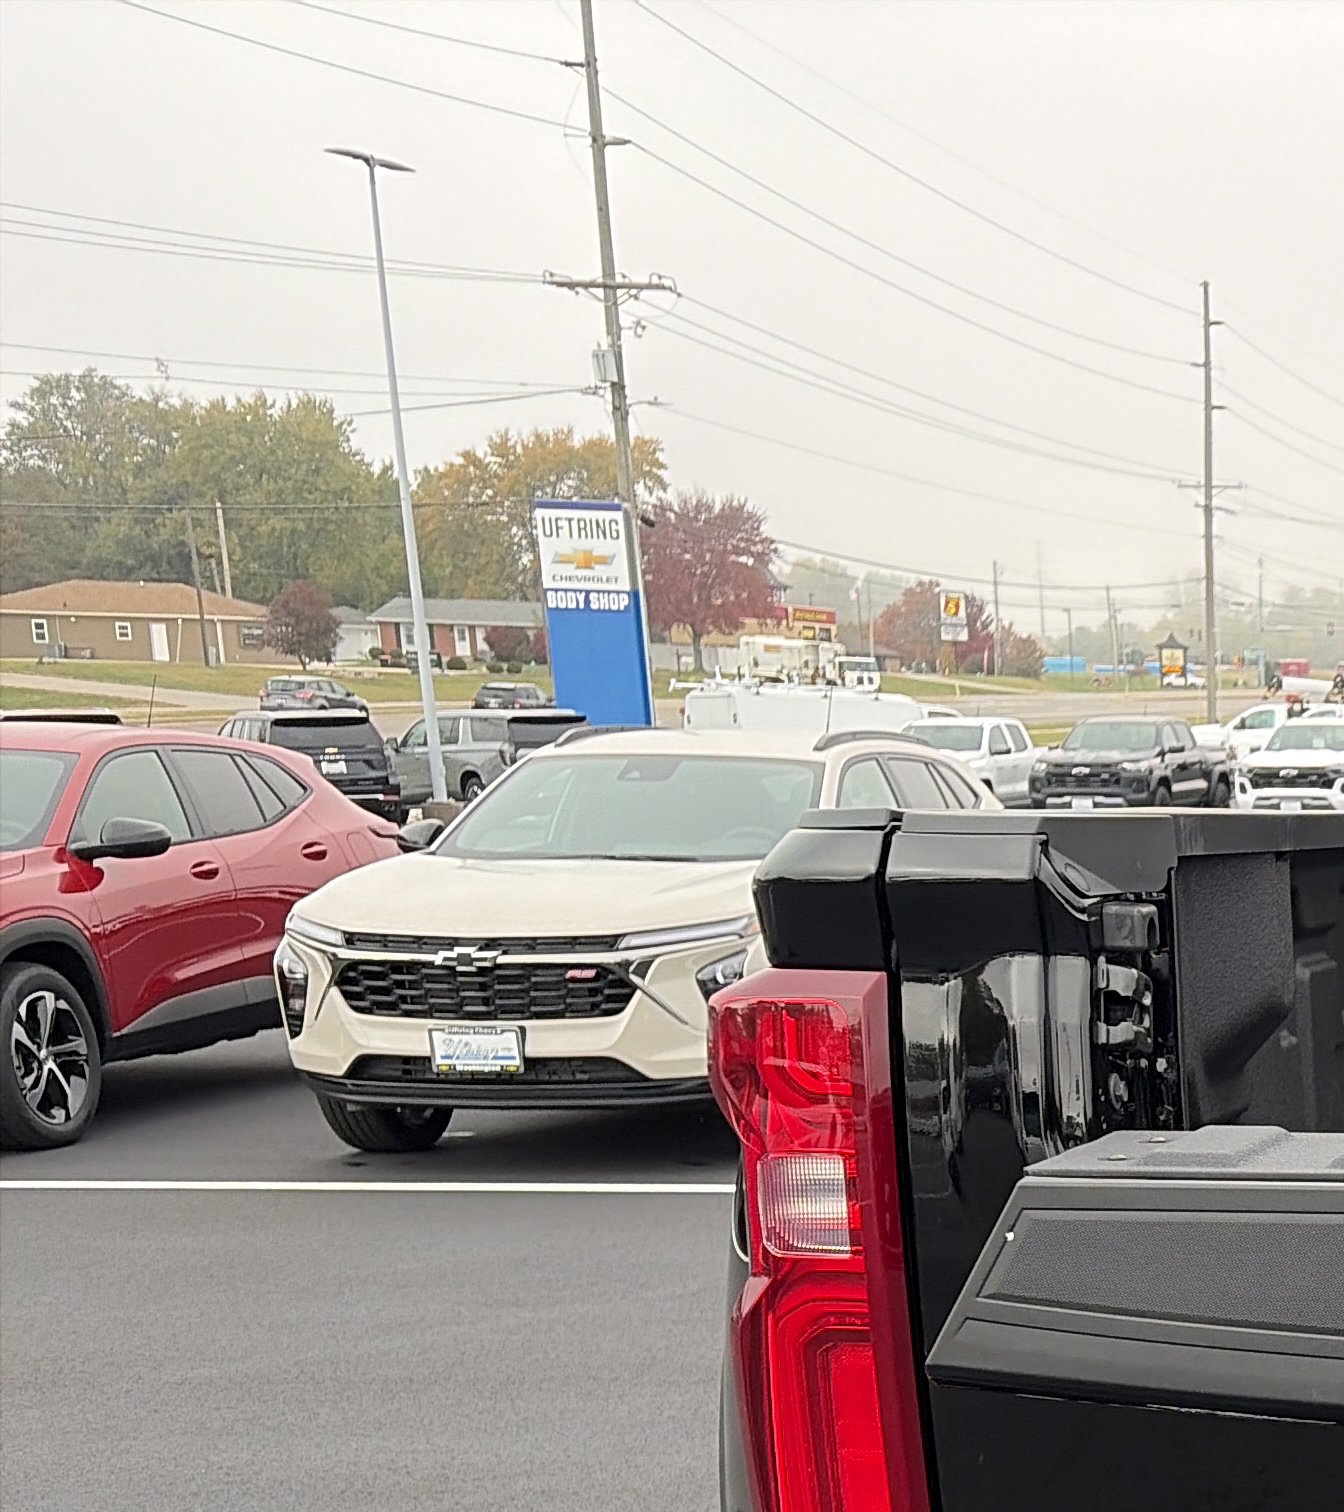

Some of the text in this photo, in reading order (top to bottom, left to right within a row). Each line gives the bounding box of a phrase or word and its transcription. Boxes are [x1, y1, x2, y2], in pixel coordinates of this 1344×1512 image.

[541, 516, 620, 540] UFTRING
[551, 574, 619, 585] CHEVROLET
[546, 590, 629, 611] BODY SHOP
